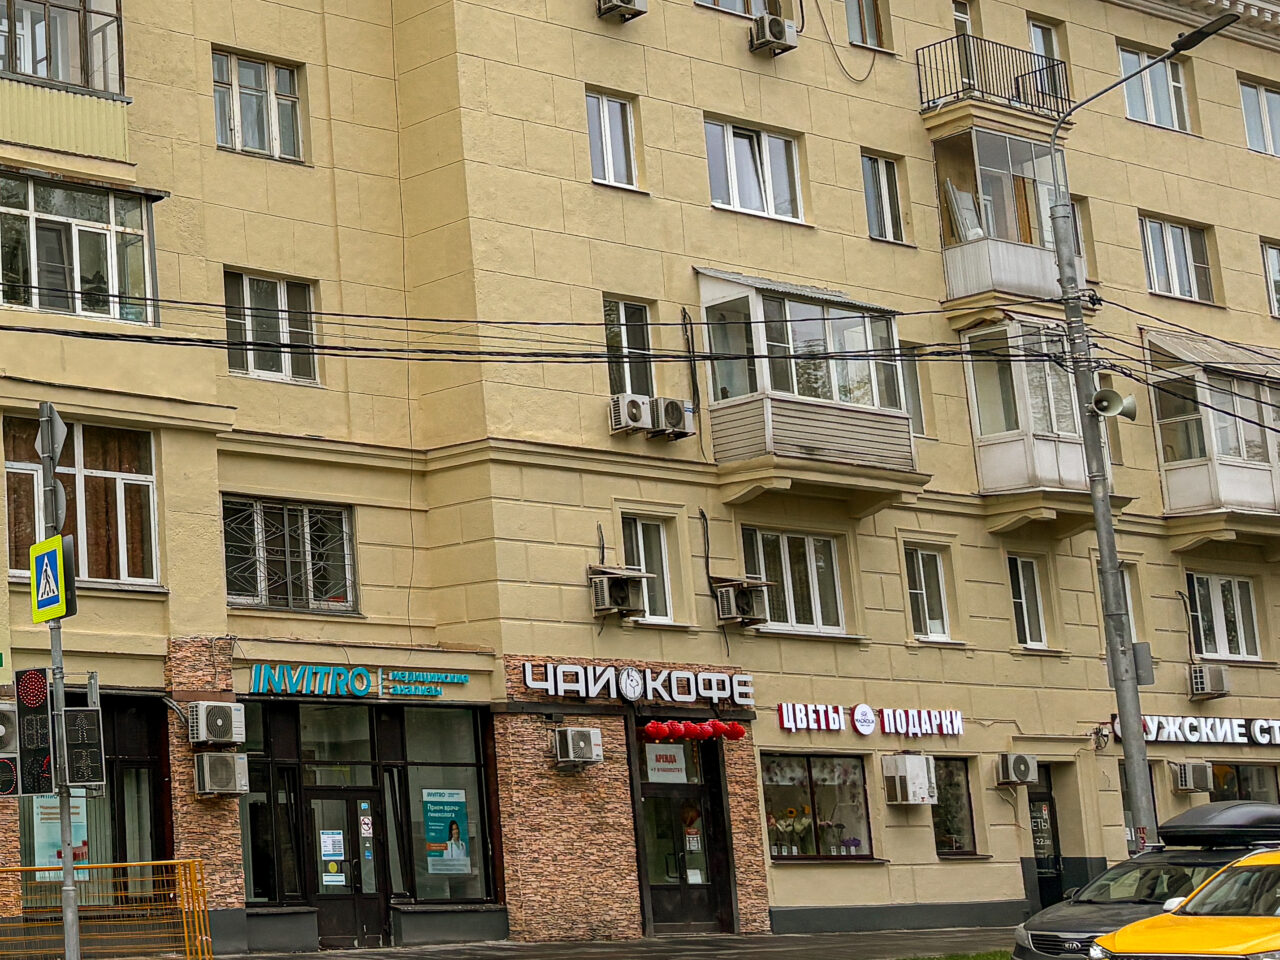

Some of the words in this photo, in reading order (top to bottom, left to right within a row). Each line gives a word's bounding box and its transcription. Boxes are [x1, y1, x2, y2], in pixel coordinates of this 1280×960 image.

[251, 663, 372, 697] INVITRO
[389, 670, 470, 684] медицинские
[389, 684, 443, 696] анализы
[644, 668, 756, 706] КОФЕ
[779, 702, 846, 733] ЦВЕТЫ
[879, 708, 964, 737] ПОДАРКИ
[1141, 715, 1249, 743] УЖСКИЕ
